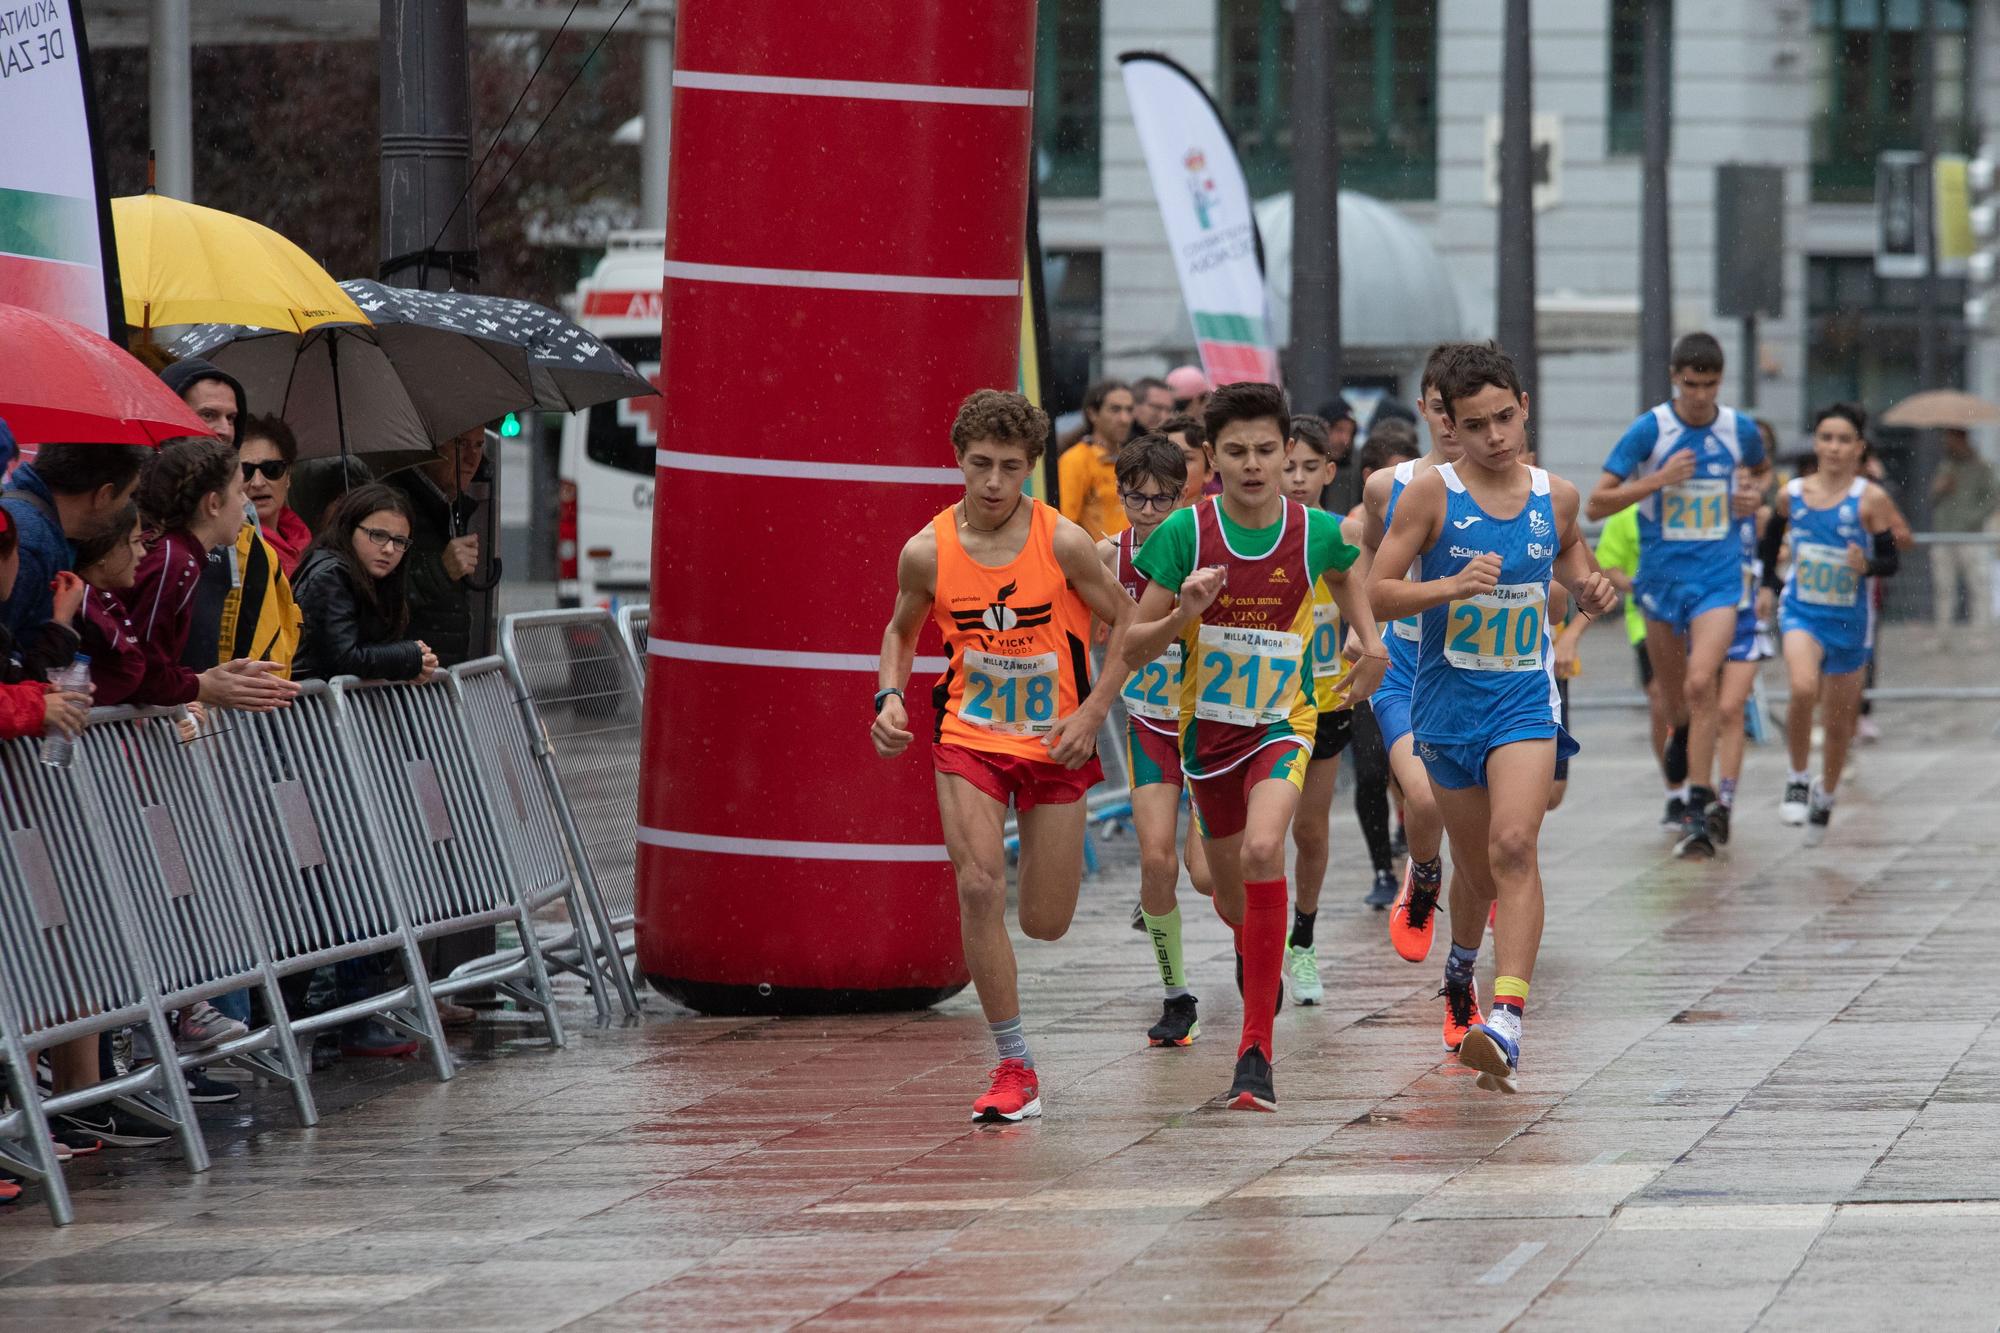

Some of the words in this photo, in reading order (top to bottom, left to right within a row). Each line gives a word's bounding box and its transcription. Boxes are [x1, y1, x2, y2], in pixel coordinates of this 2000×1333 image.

[1666, 496, 1722, 529] 211
[1236, 598, 1255, 606] CAJA
[1257, 597, 1282, 605] RURAL
[1231, 611, 1268, 622] VINO
[1449, 604, 1539, 657] 210
[998, 636, 1035, 648] VICKY
[1002, 647, 1033, 655] FOODS
[1201, 651, 1297, 709] 217
[964, 671, 1054, 723] 218
